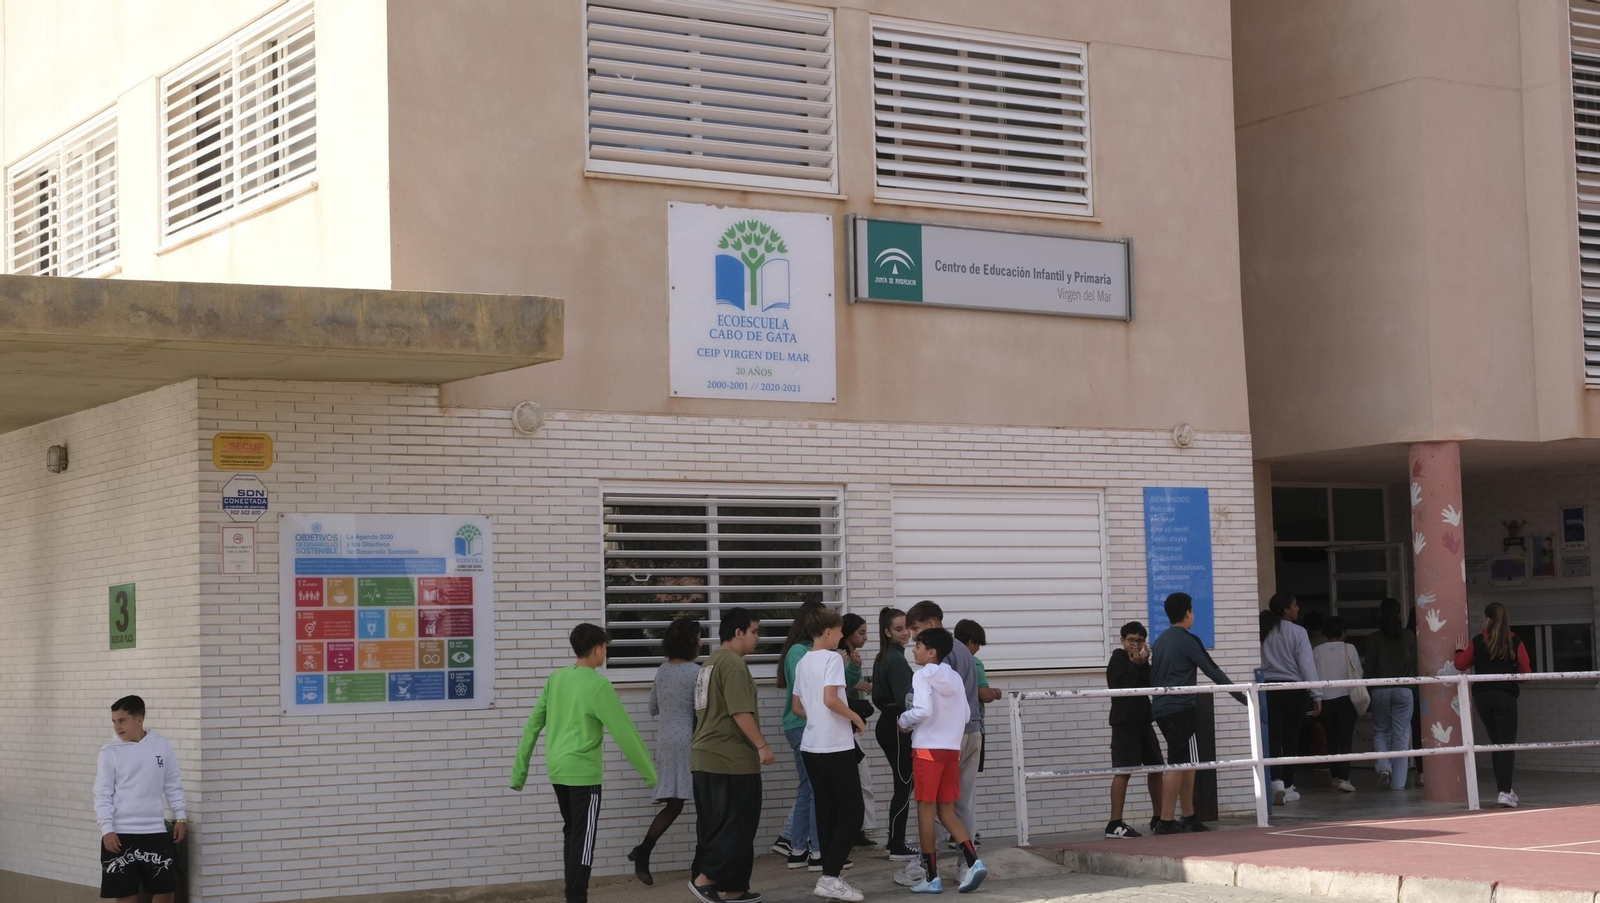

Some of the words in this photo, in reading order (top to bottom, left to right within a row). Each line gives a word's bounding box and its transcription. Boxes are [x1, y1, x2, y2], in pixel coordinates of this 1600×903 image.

[935, 260, 966, 274] Centro
[969, 262, 980, 274] de
[984, 264, 1030, 279] Educación
[1033, 267, 1064, 281] Infantil
[1066, 273, 1072, 284] y
[1074, 271, 1112, 285] Primaria
[1057, 287, 1081, 303] Virgen
[1083, 288, 1094, 301] del
[1097, 290, 1112, 303] Mar
[717, 314, 789, 330] ECOESCUELA
[709, 328, 743, 341] CABO
[746, 330, 762, 342] DE
[766, 331, 797, 343] GATA
[697, 348, 720, 358] CEIP
[723, 349, 762, 360] VIRGEN
[765, 351, 784, 361] DEL
[787, 353, 810, 362] MAR
[736, 367, 745, 375] 20
[748, 366, 772, 376] AÑOS
[707, 381, 748, 390] 2000-2001
[761, 383, 801, 392] 2020-2021
[295, 533, 338, 542] OBJETIVOS
[115, 591, 129, 632] 3
